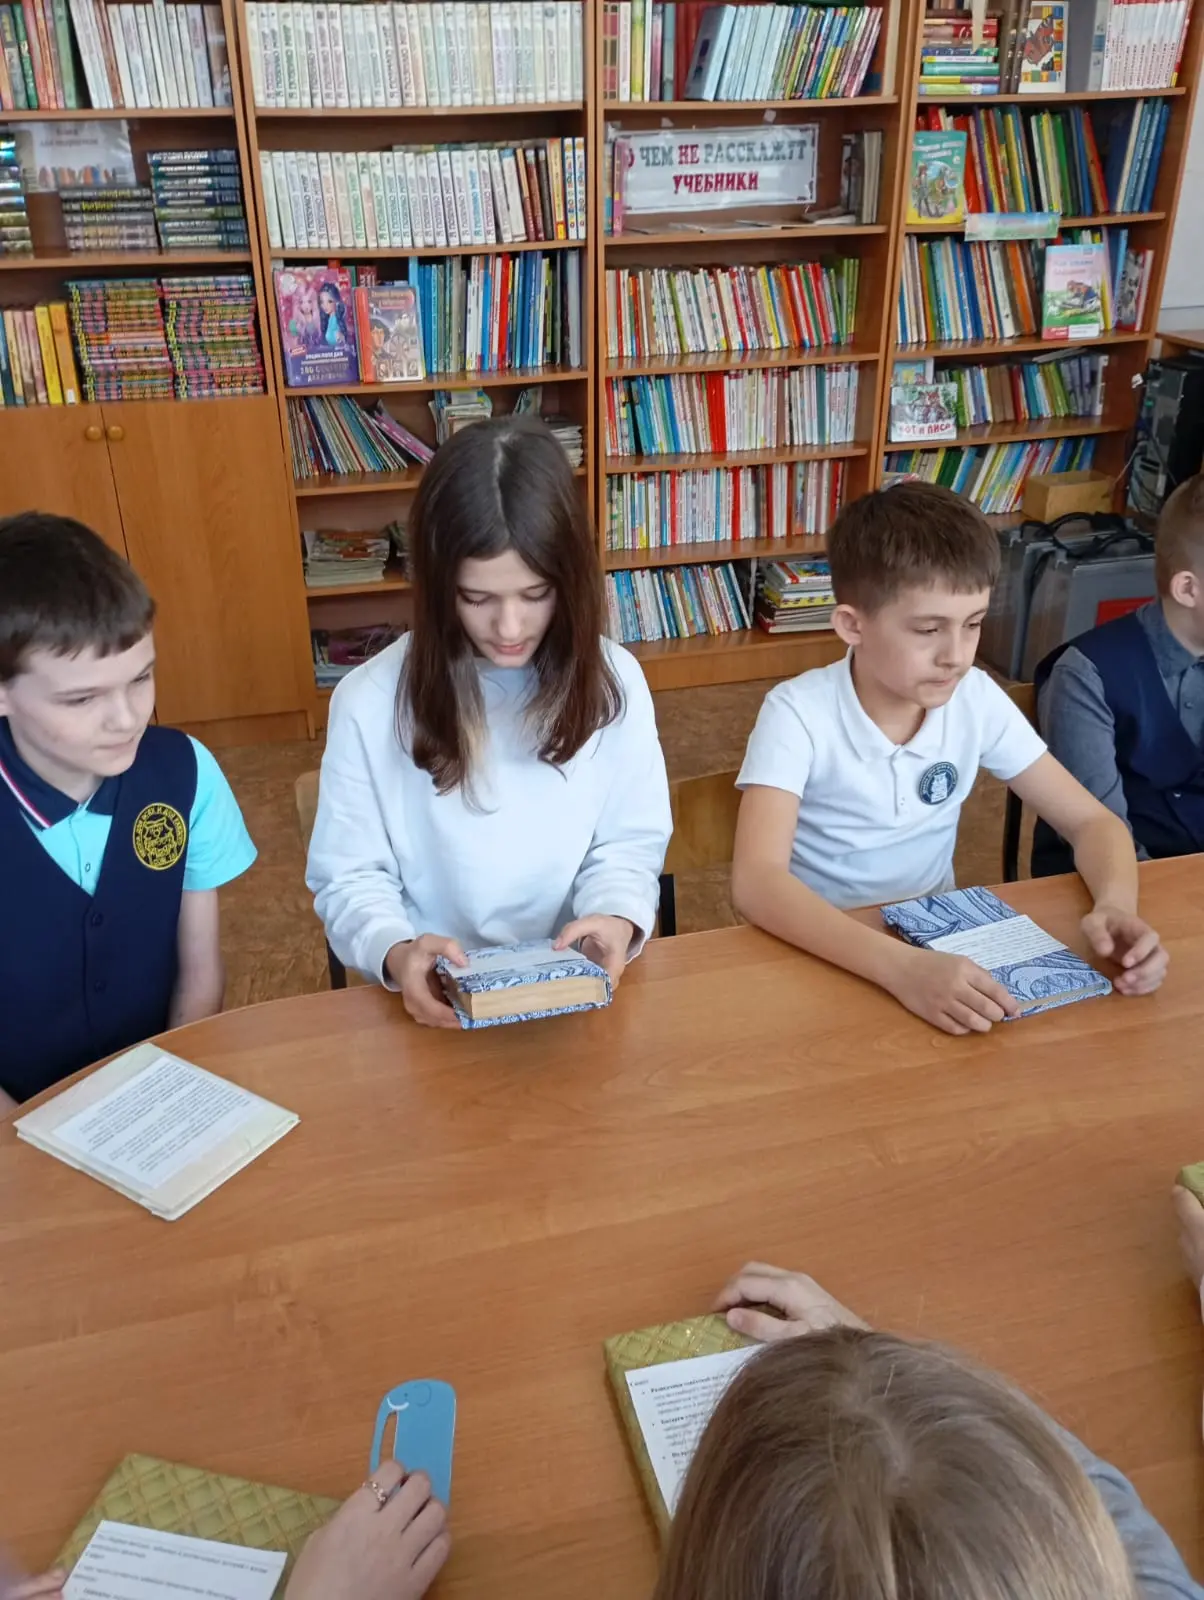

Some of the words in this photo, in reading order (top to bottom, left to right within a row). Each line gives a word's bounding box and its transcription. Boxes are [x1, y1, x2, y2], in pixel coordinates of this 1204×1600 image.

[640, 146, 674, 167] ЧЕМ
[678, 144, 700, 165] НЕ
[704, 139, 807, 164] РАССКАЖУТ
[673, 171, 759, 194] УЧЕБНИКИ
